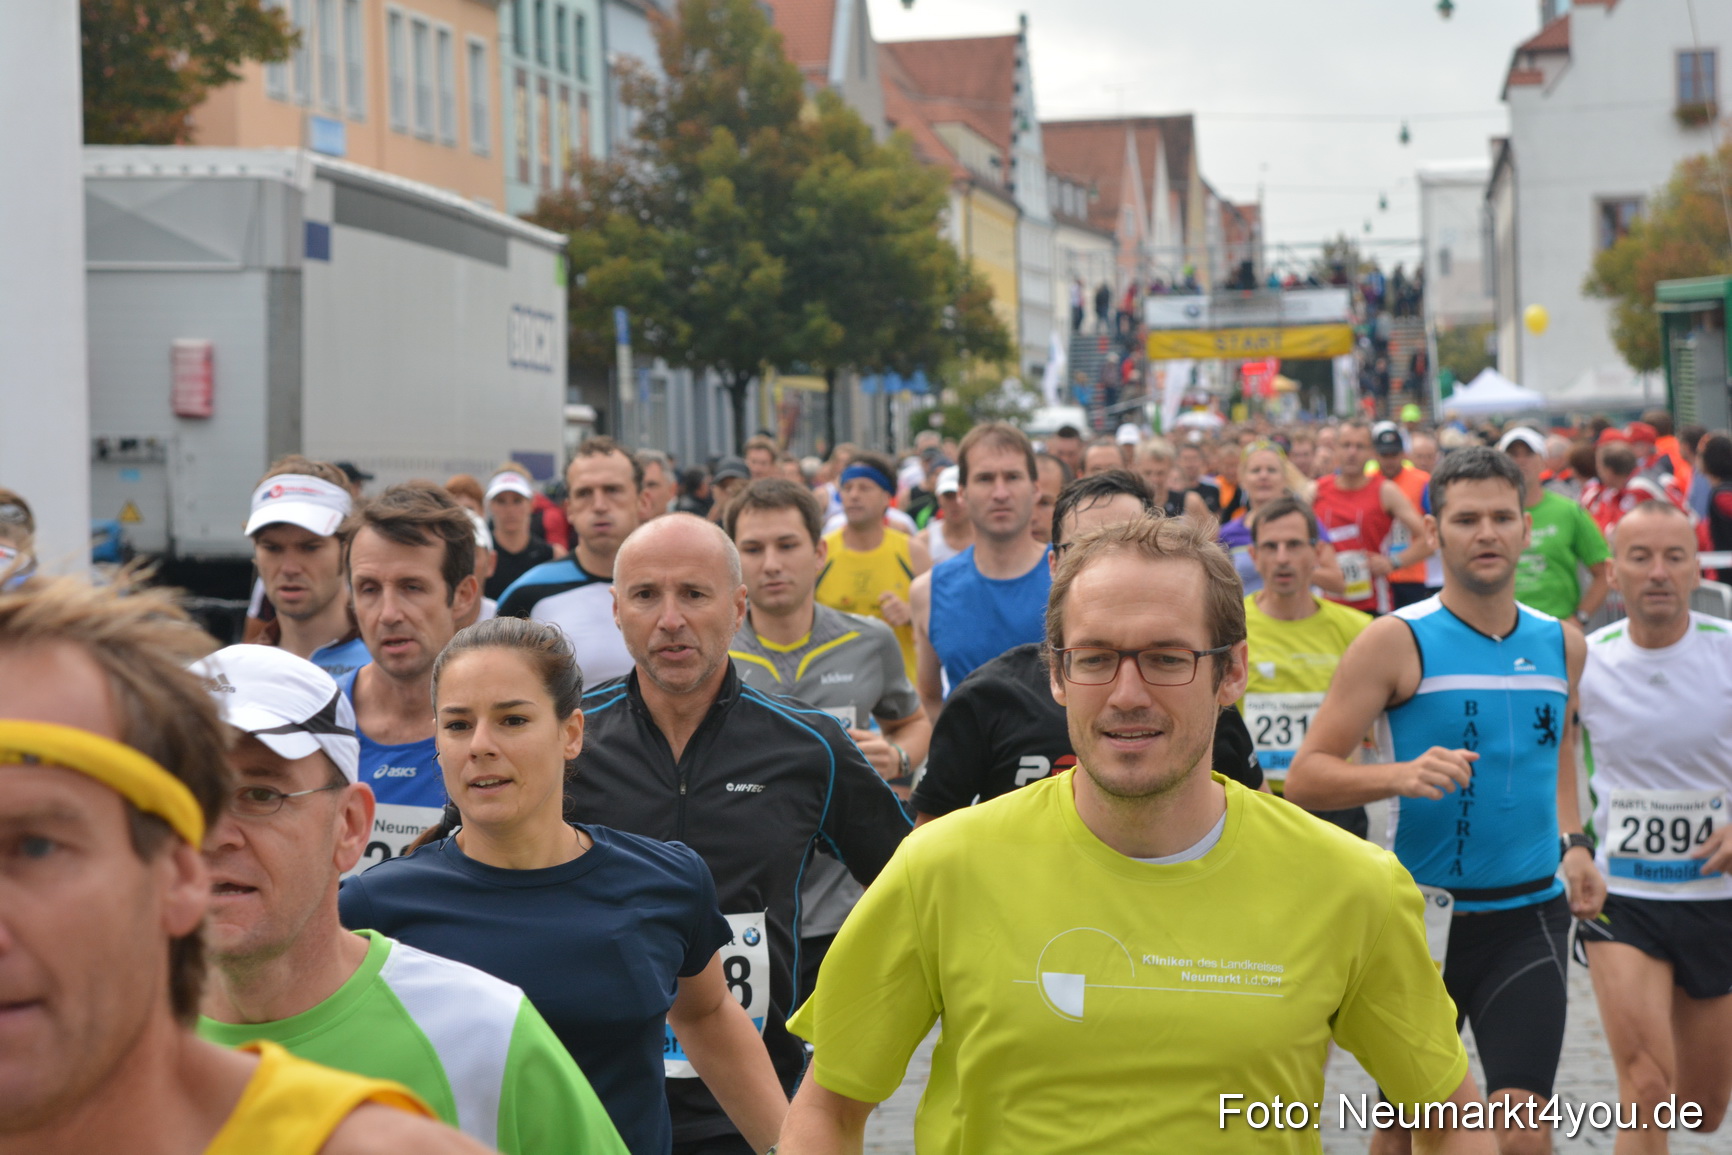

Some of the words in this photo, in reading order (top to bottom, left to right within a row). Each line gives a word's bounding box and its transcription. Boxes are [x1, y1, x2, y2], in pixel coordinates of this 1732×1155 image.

[1215, 334, 1281, 350] START
[387, 767, 417, 777] asics
[734, 783, 764, 793] HI-TEC
[1448, 700, 1479, 876] BAVRTRIA
[1620, 816, 1713, 854] 2894
[1142, 954, 1193, 967] Kliniken
[1197, 958, 1217, 969] des
[1220, 958, 1284, 973] Landkreises
[1181, 971, 1241, 984] Neumarkt
